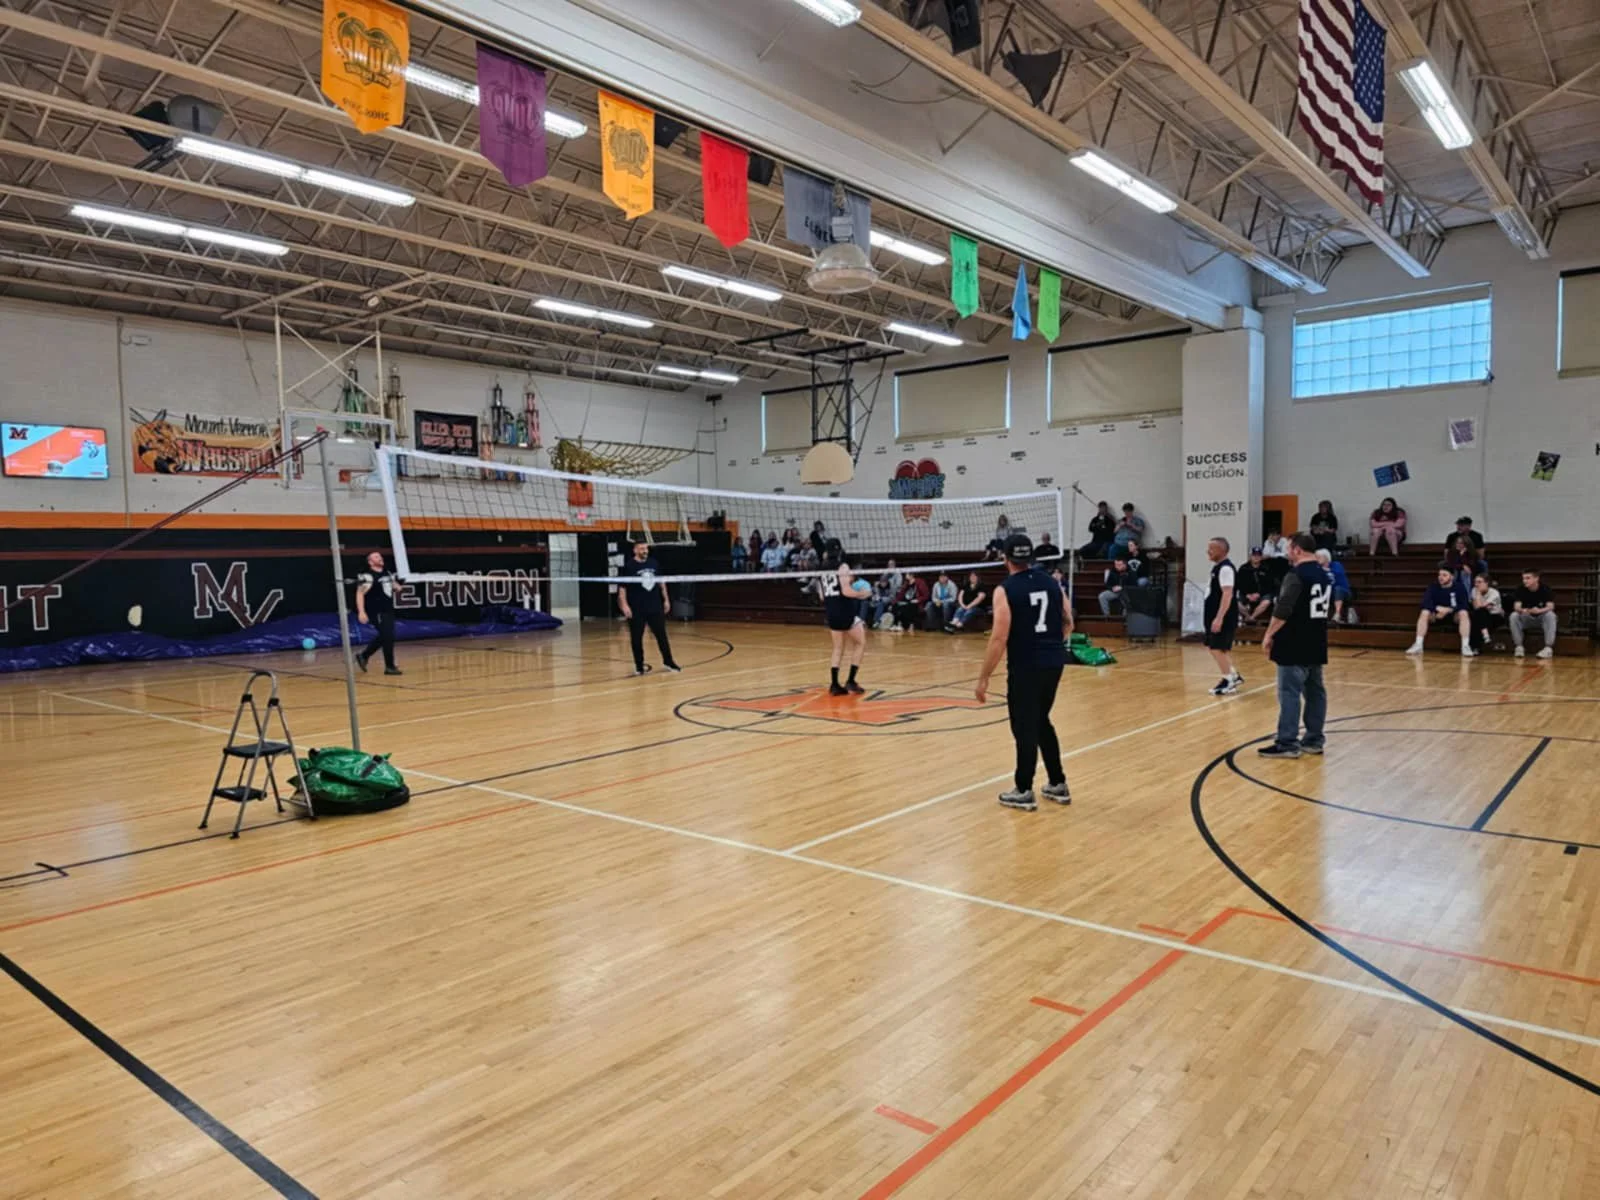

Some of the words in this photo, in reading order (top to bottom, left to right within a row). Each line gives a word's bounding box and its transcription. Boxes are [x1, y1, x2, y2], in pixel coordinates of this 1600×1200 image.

[9, 427, 28, 440] M
[185, 413, 226, 434] Mount
[1187, 452, 1247, 465] SUCCESS
[1191, 501, 1243, 512] MINDSET
[393, 568, 540, 609] ERNON
[0, 584, 62, 632] T
[1029, 591, 1049, 632] 7
